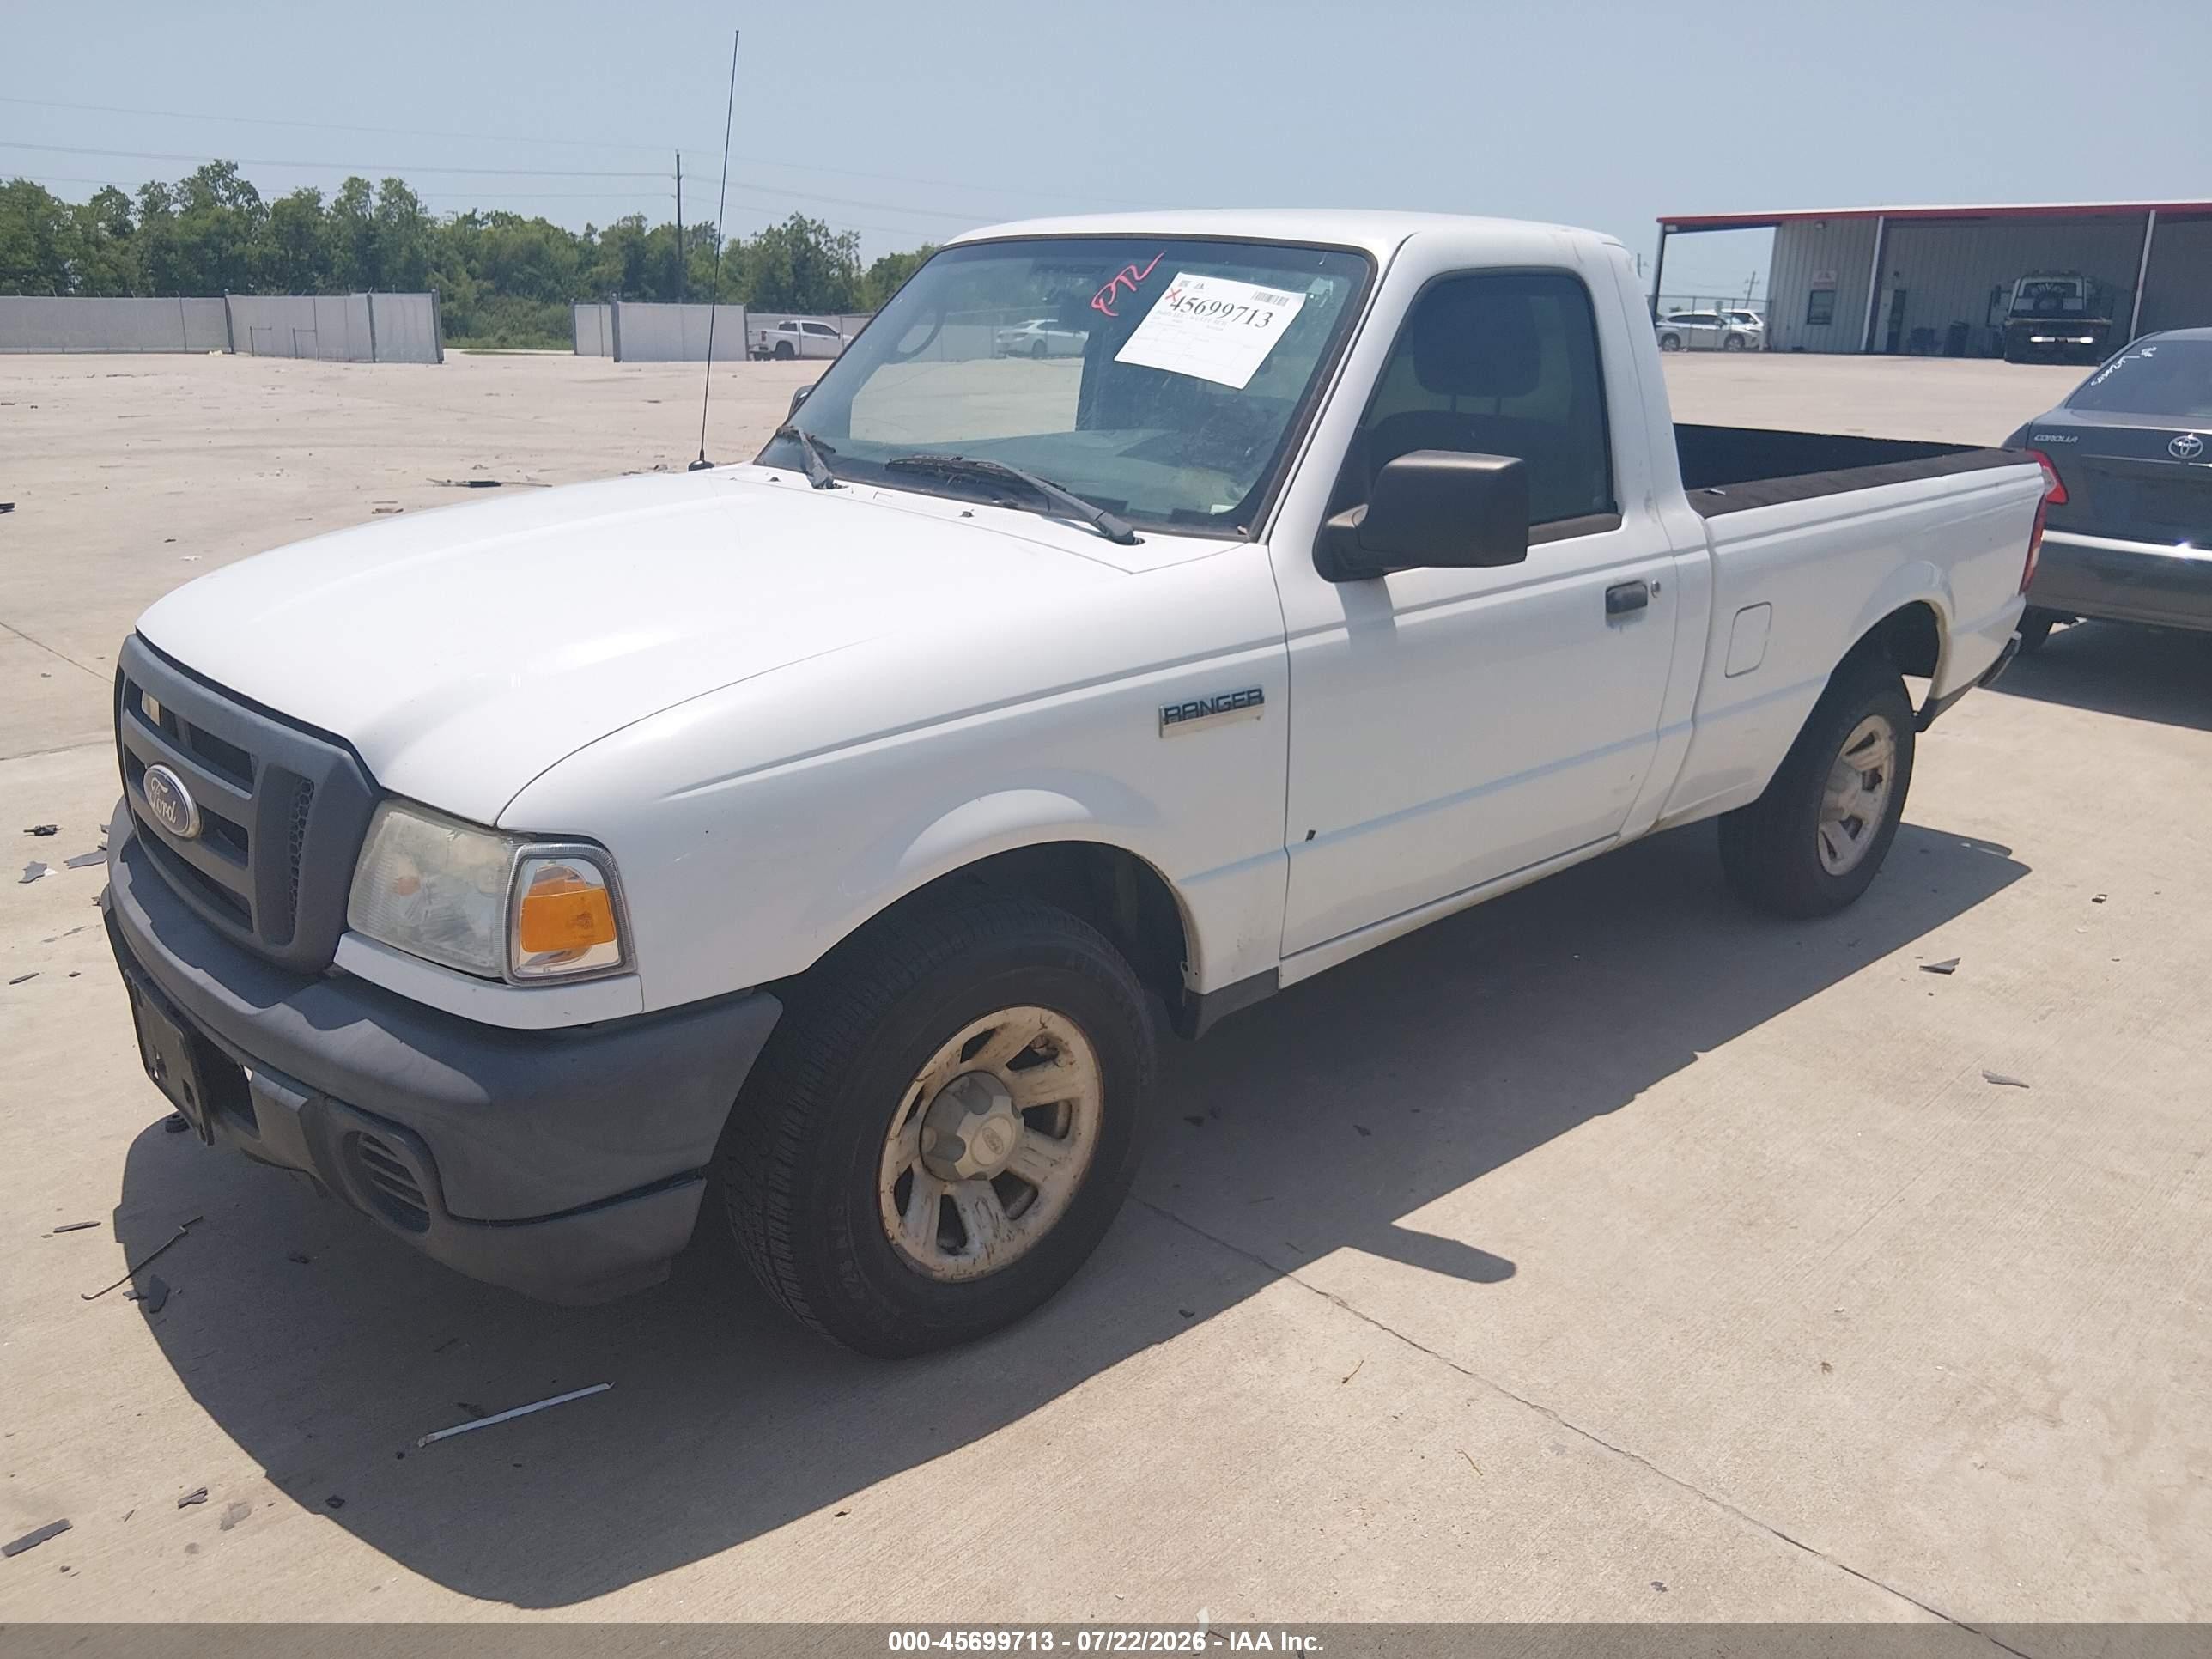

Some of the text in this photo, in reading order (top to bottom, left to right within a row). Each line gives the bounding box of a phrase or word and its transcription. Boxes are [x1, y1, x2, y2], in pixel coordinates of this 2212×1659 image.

[1170, 295, 1273, 328] 45699713
[2034, 434, 2078, 443] COROLLA
[1164, 688, 1265, 725] RANGER
[149, 776, 177, 824] Ford
